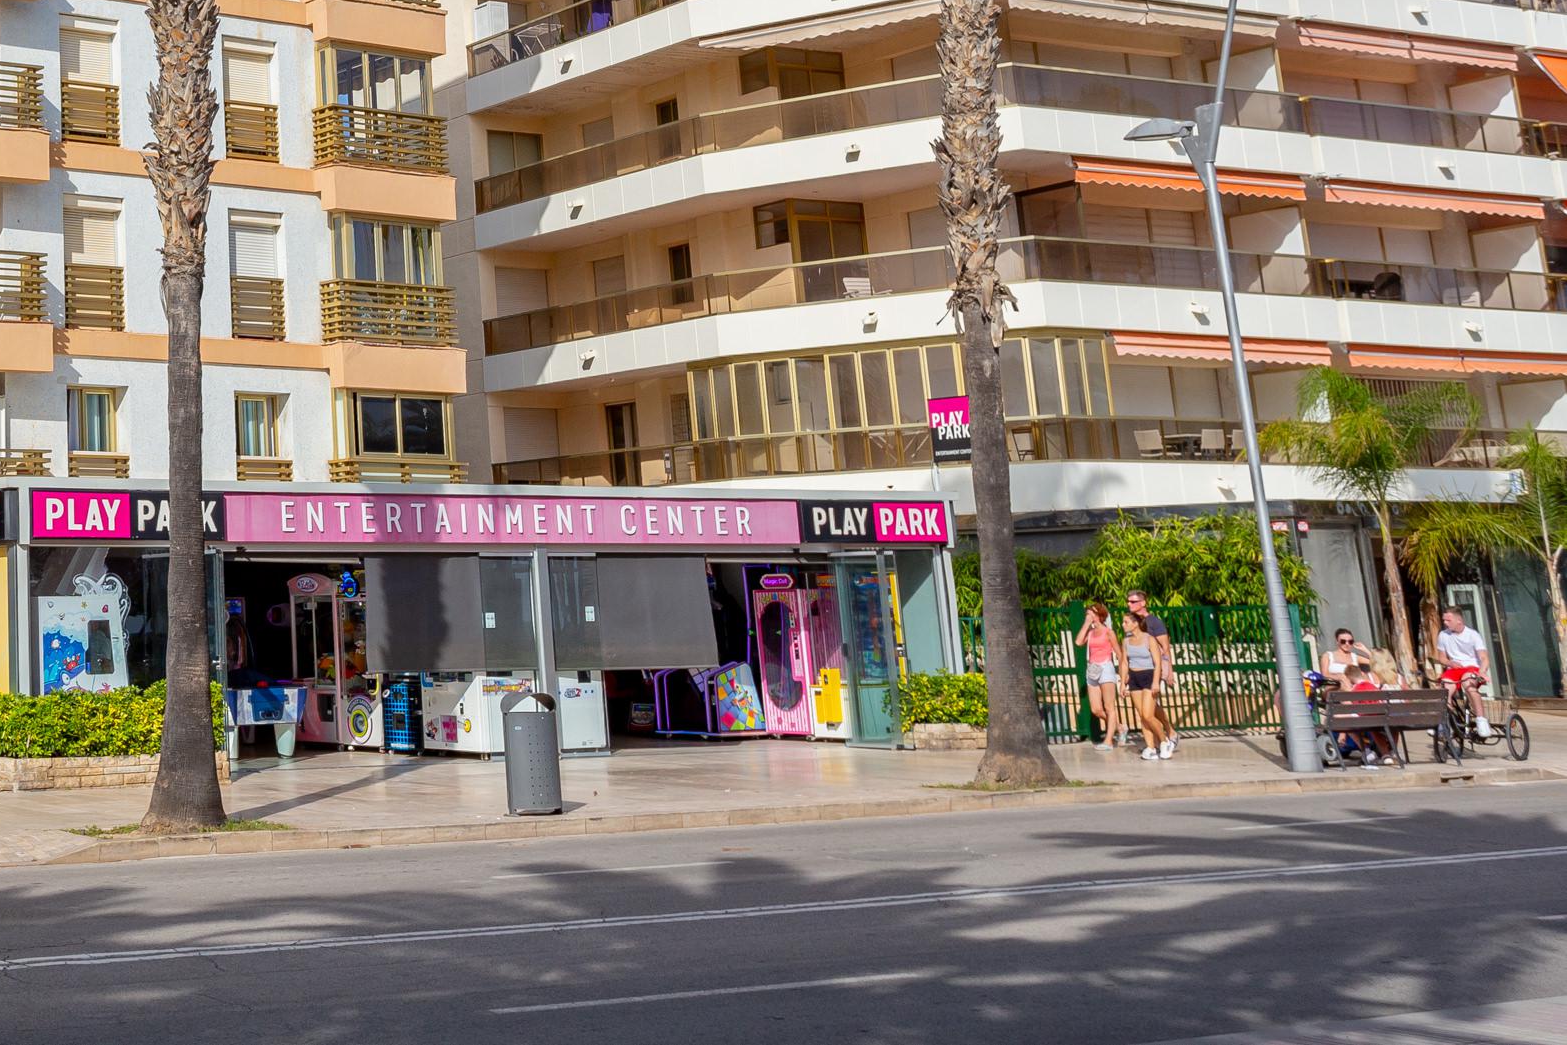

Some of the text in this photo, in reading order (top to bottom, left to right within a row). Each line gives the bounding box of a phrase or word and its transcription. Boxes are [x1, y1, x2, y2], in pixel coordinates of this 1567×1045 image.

[931, 410, 963, 428] PLAY
[937, 423, 971, 440] PARK
[45, 497, 218, 533] PLAY PAK
[281, 501, 752, 536] ENTERTAINMENT CENTER
[812, 506, 941, 536] PLAY PARK
